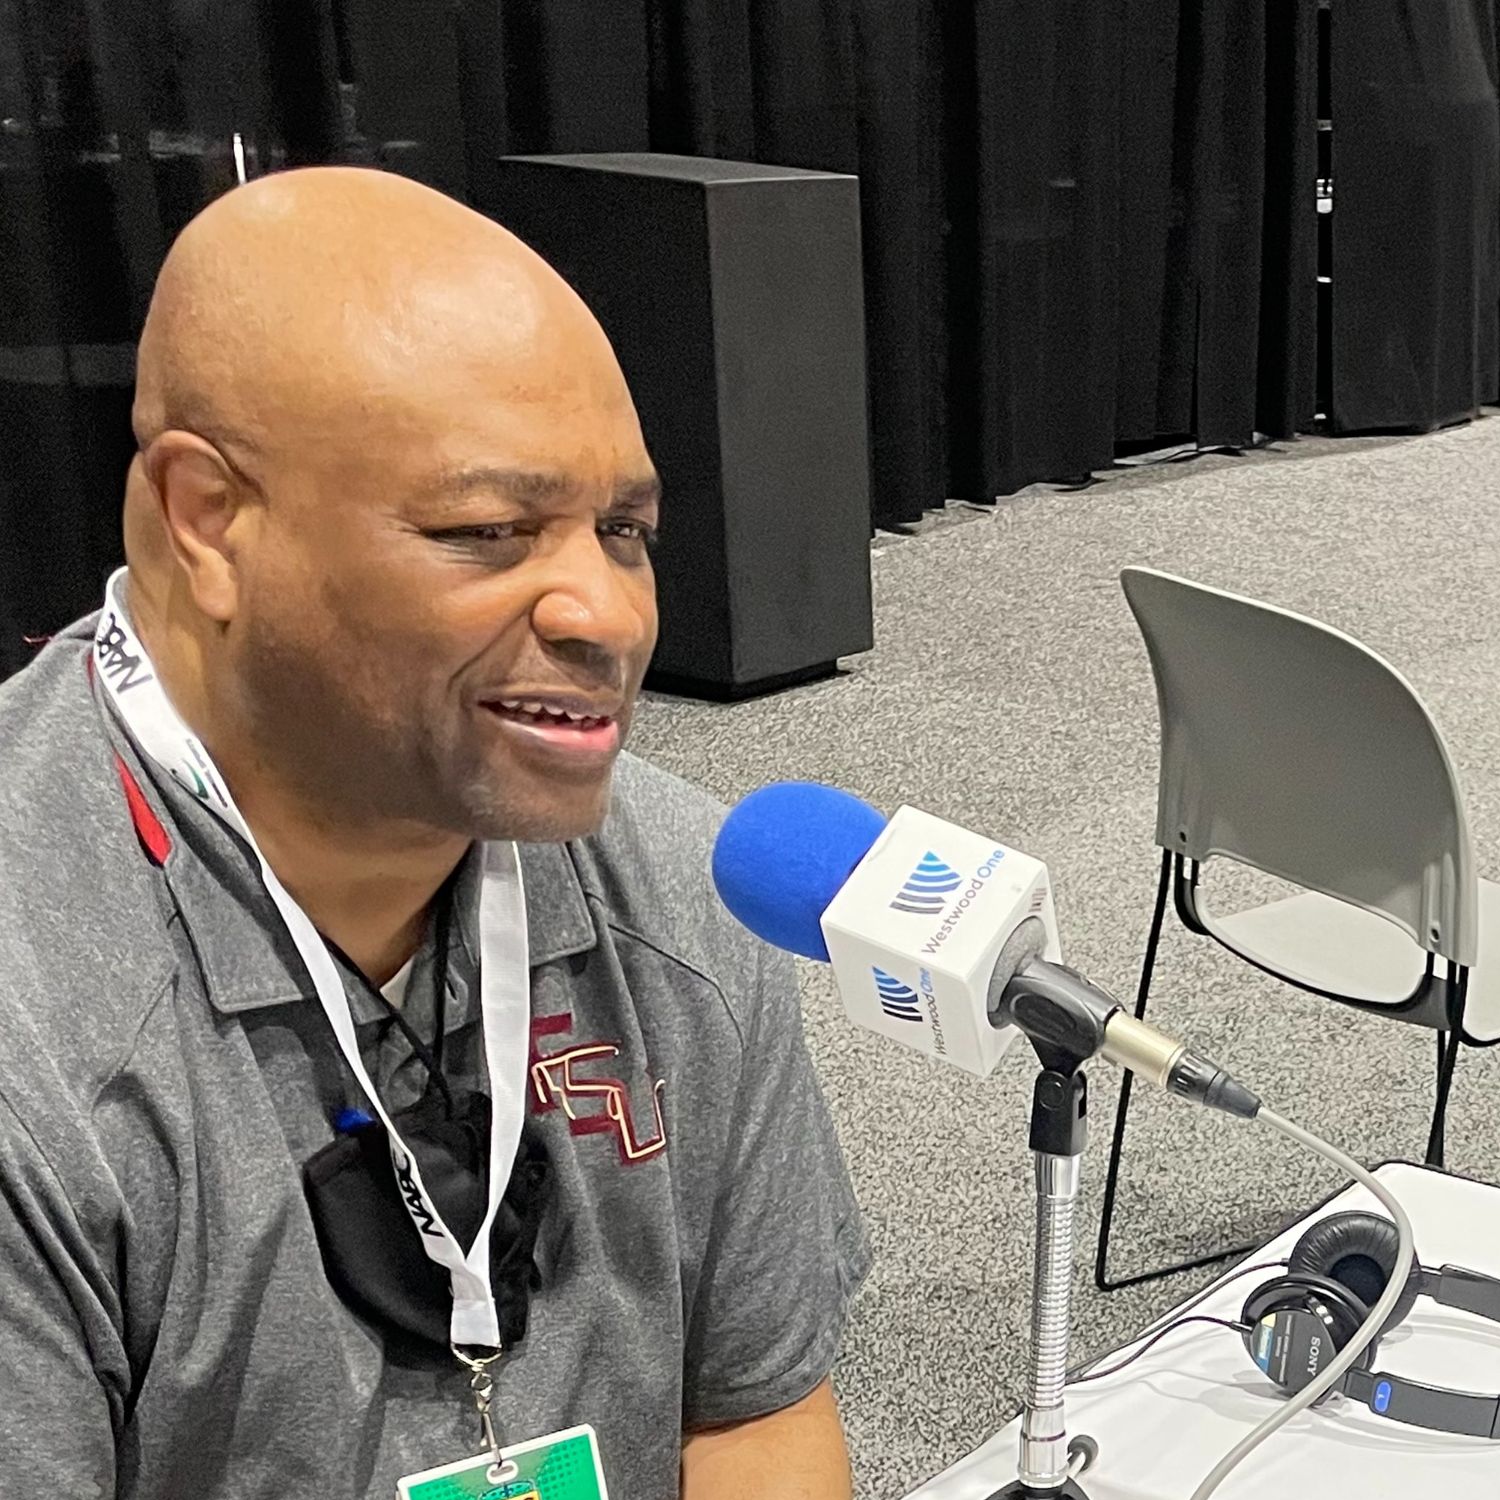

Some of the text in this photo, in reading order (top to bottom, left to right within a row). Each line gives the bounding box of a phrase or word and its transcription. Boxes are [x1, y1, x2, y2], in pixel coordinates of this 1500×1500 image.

[921, 848, 1005, 955] Westwood One
[918, 966, 948, 1056] Westwood One
[392, 1148, 445, 1238] NABC
[1307, 1336, 1321, 1377] SONY
